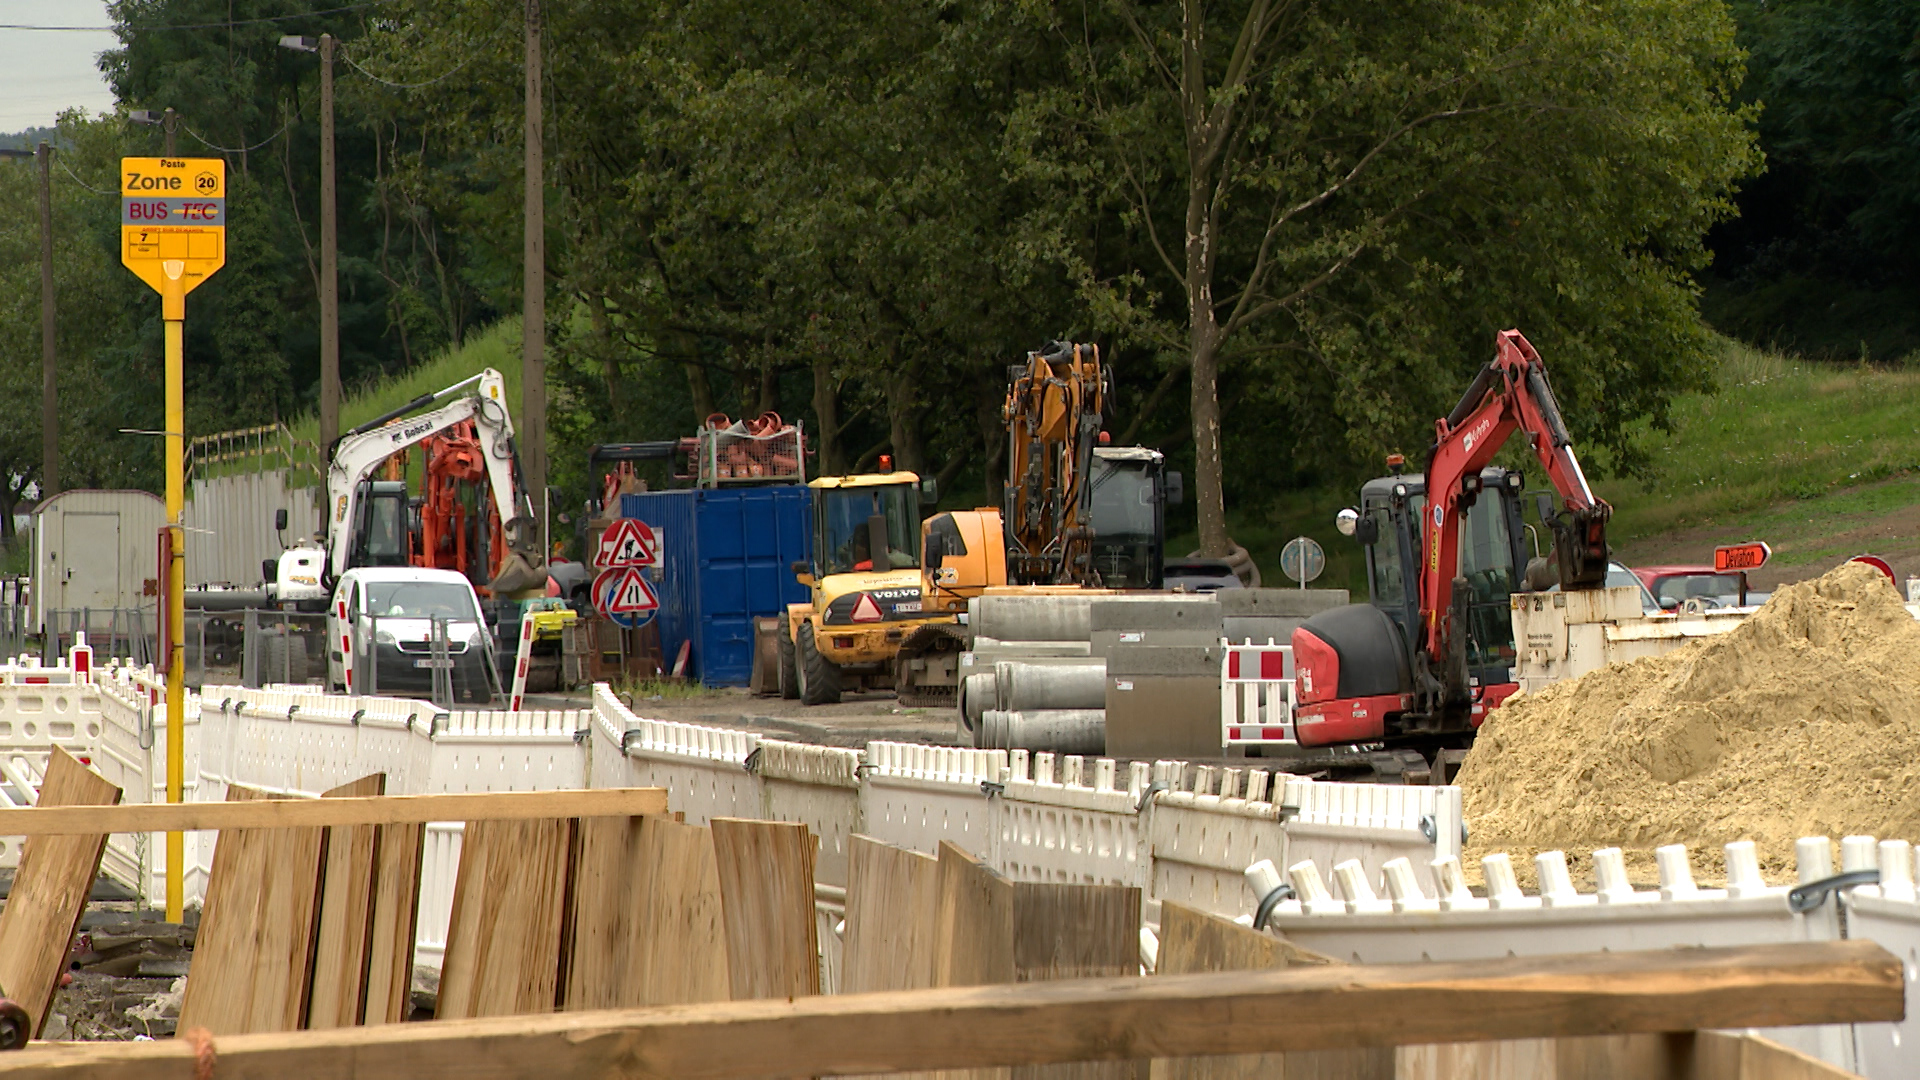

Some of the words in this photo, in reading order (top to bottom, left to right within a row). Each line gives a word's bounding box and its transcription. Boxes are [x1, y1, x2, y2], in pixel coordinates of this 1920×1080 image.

[160, 159, 185, 168] Poste
[126, 173, 182, 190] Zone
[198, 177, 215, 189] 20
[129, 202, 168, 220] BUS
[181, 202, 218, 220] TEC
[139, 233, 148, 242] 7
[404, 421, 434, 439] Bobcat
[874, 589, 920, 600] VOLVO
